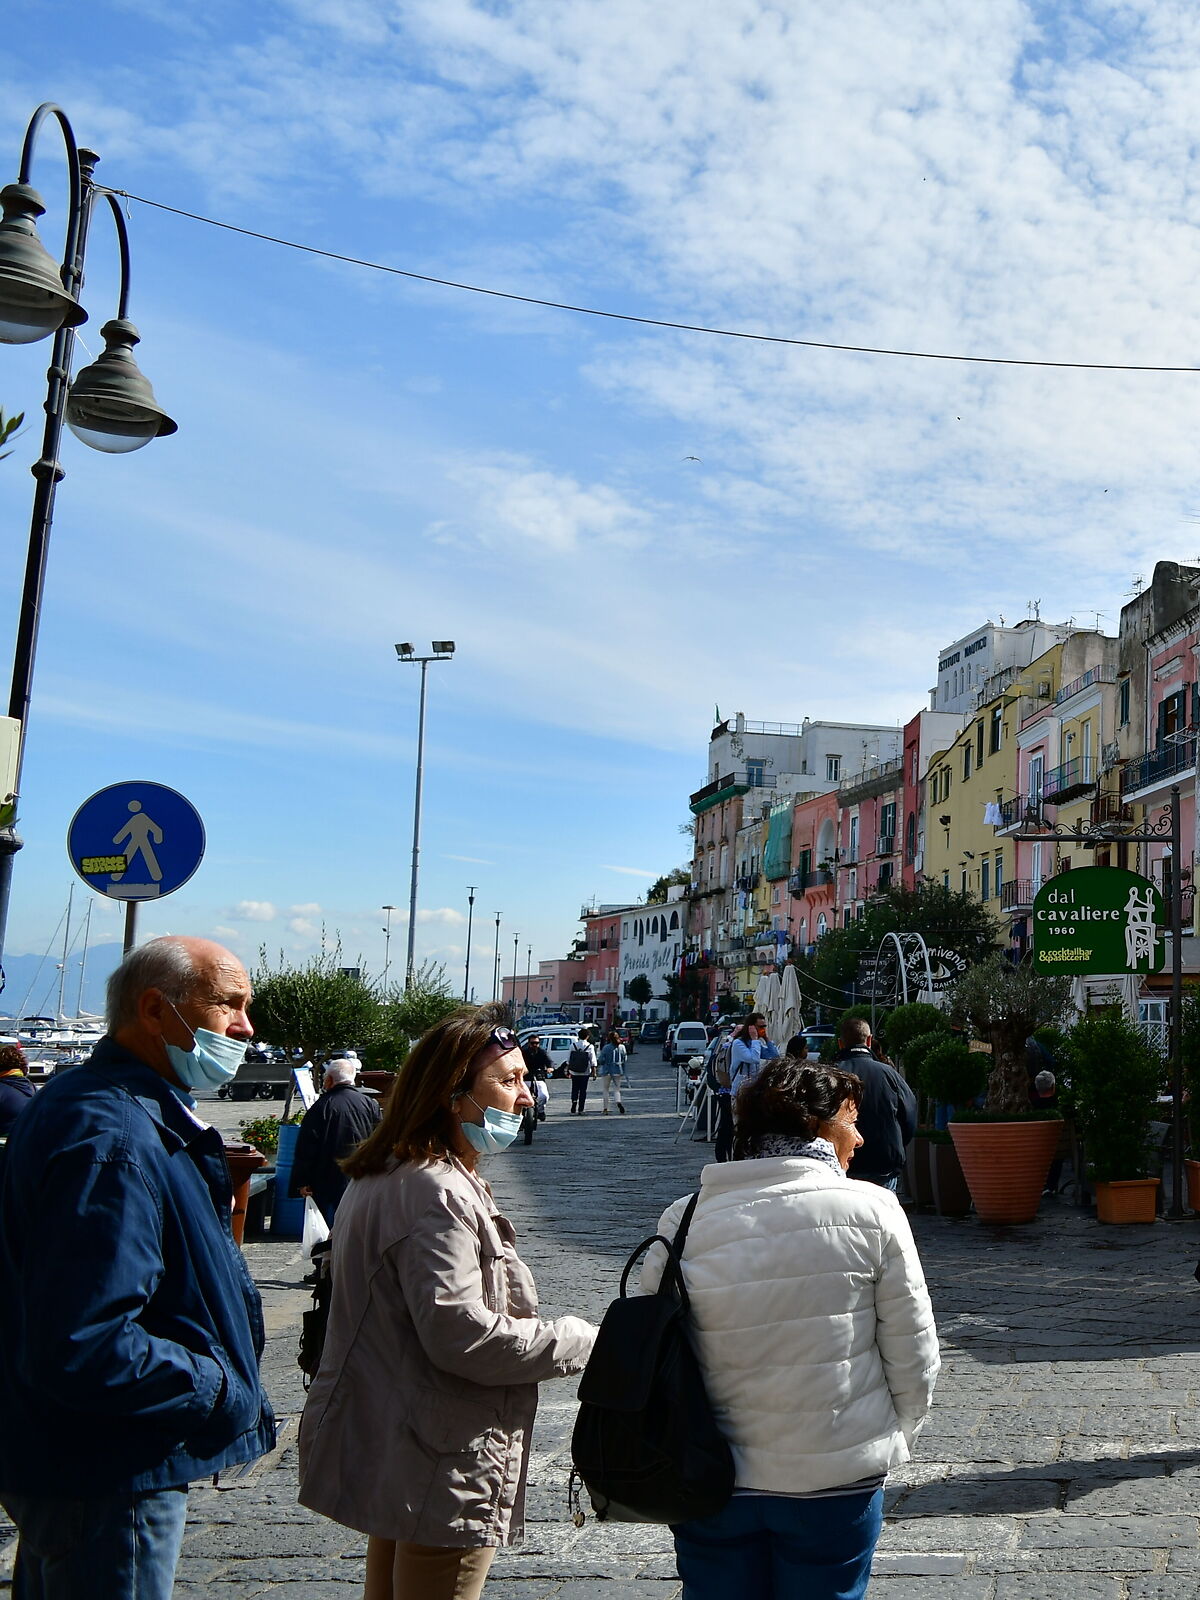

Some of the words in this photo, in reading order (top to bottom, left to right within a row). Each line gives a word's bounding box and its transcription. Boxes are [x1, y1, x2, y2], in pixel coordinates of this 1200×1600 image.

[938, 651, 960, 672] ISTITUTO
[964, 636, 987, 658] NAUTICO
[1048, 888, 1075, 903] dal
[1037, 906, 1120, 920] cavaliere
[1048, 927, 1075, 935] 1960
